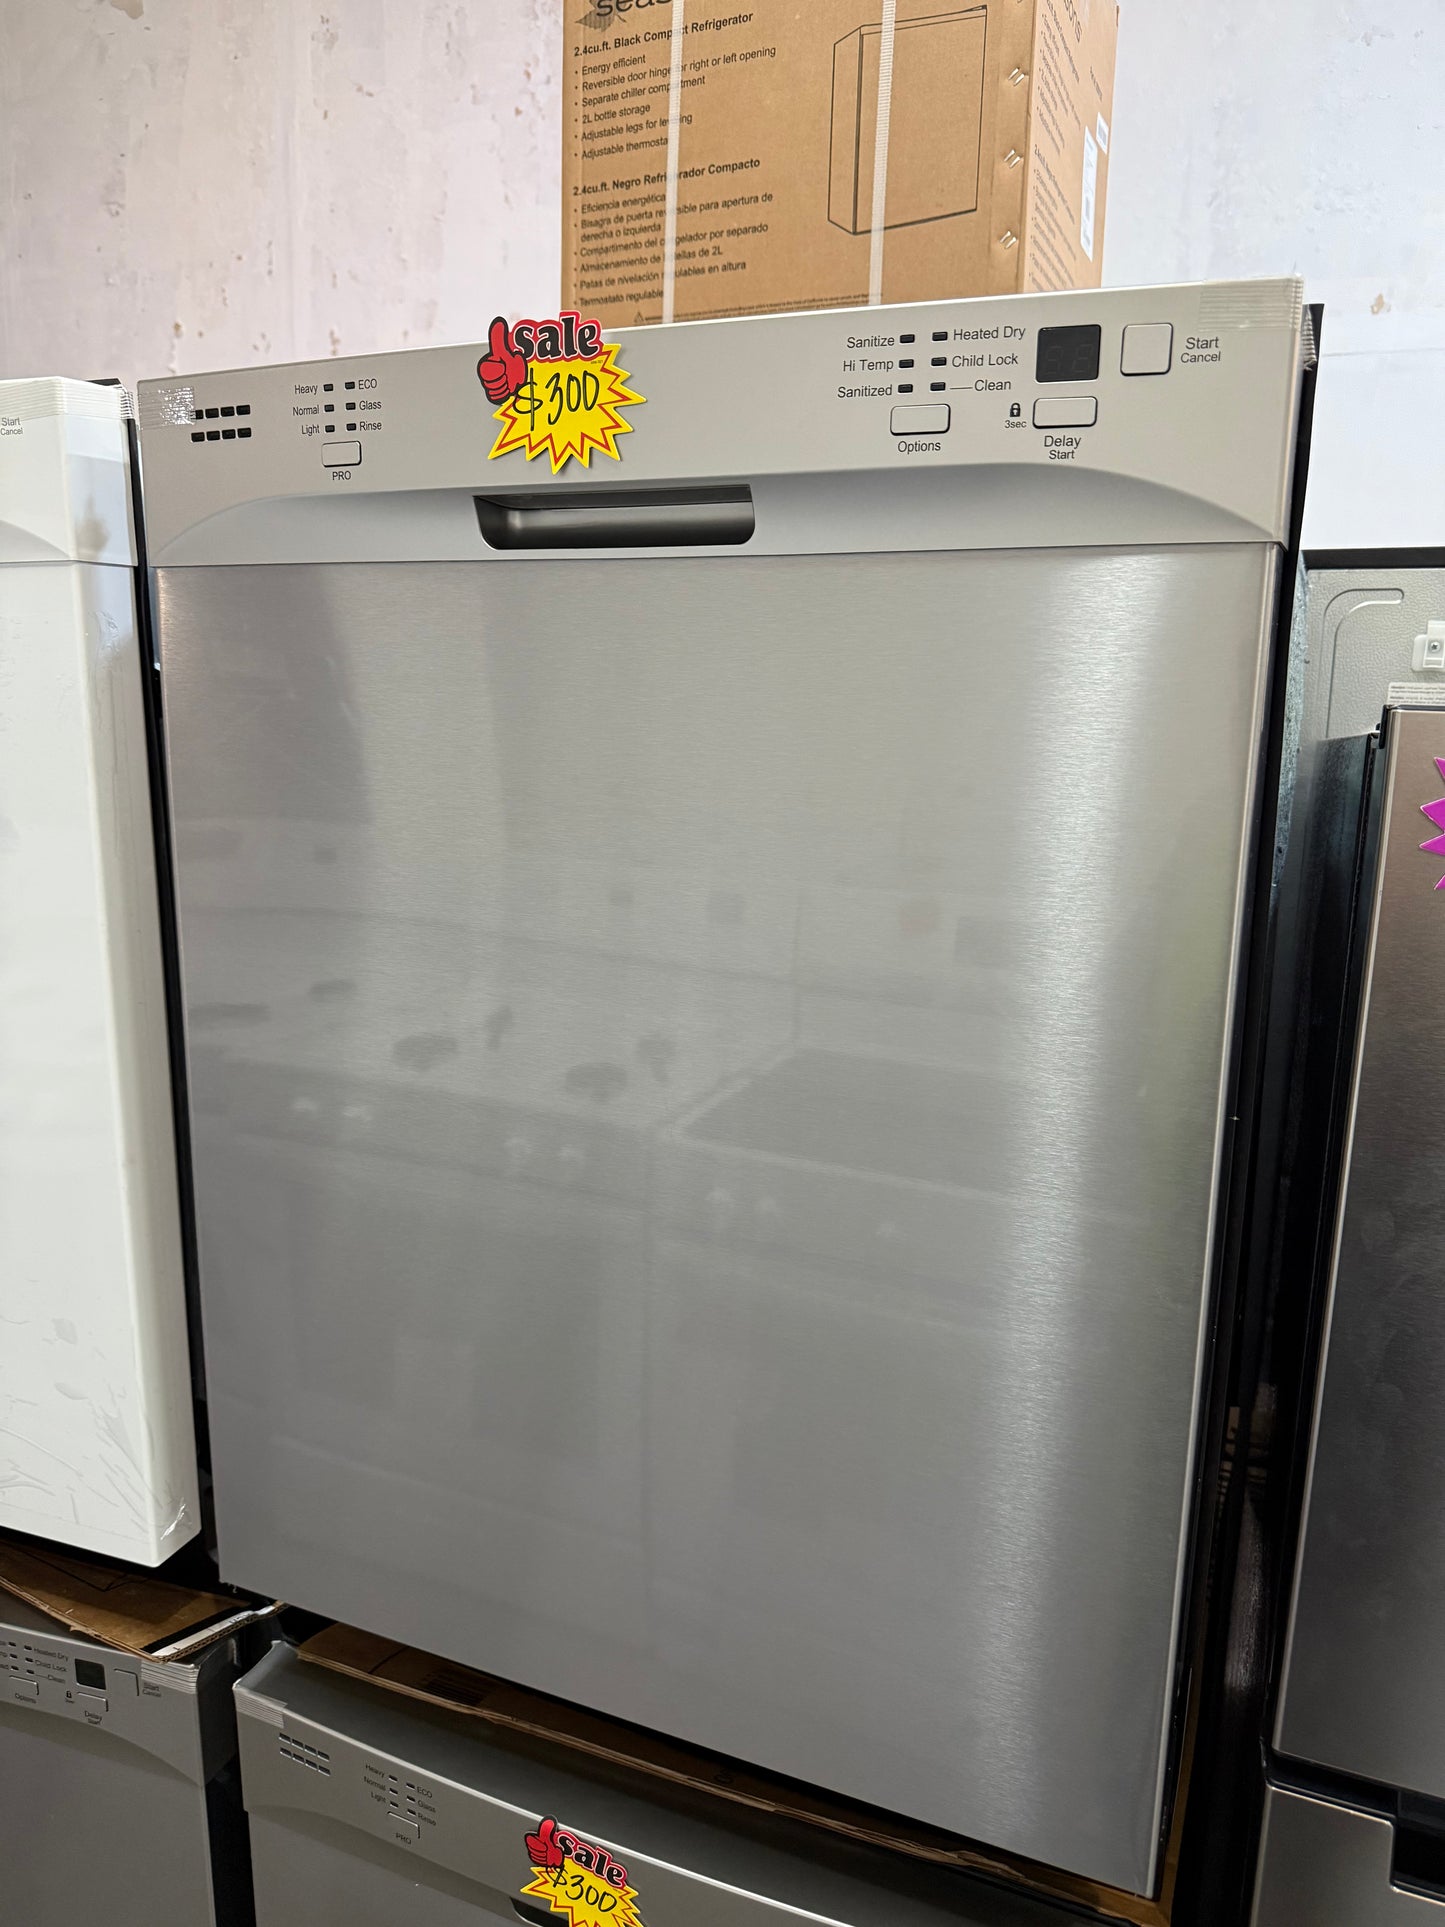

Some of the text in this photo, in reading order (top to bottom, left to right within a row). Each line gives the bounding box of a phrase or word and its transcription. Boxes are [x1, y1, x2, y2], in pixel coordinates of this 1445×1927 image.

[574, 41, 611, 57] 2.4cu.ft.
[614, 35, 641, 49] Black
[691, 13, 754, 33] Refrigerator
[582, 54, 646, 76] Energy efficient
[582, 76, 626, 92] Reversible
[627, 70, 647, 82] door
[690, 59, 709, 72] right
[711, 57, 721, 66] or
[723, 52, 737, 64] left
[739, 47, 776, 62] opening
[582, 75, 706, 108] Separate chiller comptment
[582, 104, 651, 124] 2L bottle storage
[581, 126, 624, 142] Adjustable
[626, 122, 643, 134] legs
[645, 119, 657, 130] for
[581, 143, 624, 160] Adjustable
[573, 158, 760, 196] 2.4cu.ft. Negro Refrirador Compacto
[581, 201, 620, 214] Eficiencia
[581, 192, 773, 230] Bisagra de puerta revsible para apertura de
[580, 230, 613, 242] derecha
[623, 223, 661, 238] izquierda
[580, 241, 643, 258] Compartimento
[644, 238, 657, 248] del
[709, 229, 724, 242] por
[726, 222, 768, 238] separado
[580, 257, 648, 272] Almacenamiento
[650, 255, 661, 264] de
[698, 247, 709, 257] de
[711, 246, 723, 255] 2L
[580, 279, 603, 289] Patas
[605, 277, 615, 286] de
[707, 264, 719, 273] en
[721, 261, 746, 272] altura
[514, 315, 600, 359] sale
[953, 325, 1026, 341] Heated Dry
[847, 335, 895, 349] Sanitize
[1185, 336, 1220, 351] Start
[952, 353, 1019, 368] Child Lock
[1180, 351, 1221, 364] Cancel
[843, 358, 894, 373] Hi Temp
[294, 384, 318, 396] Heavy
[358, 378, 378, 390] ECO
[837, 384, 893, 398] Sanitized
[974, 379, 1012, 392] Clean
[358, 400, 382, 411] Glass
[512, 367, 600, 431] $300
[292, 404, 320, 417] Normal
[1, 417, 21, 427] Start
[359, 421, 383, 431] Rinse
[1004, 419, 1027, 429] 3sec
[0, 427, 24, 436] Cancel
[301, 424, 320, 436] Light
[897, 440, 941, 455] Options
[1043, 434, 1082, 450] Delay
[1048, 449, 1075, 461] Start
[332, 471, 352, 482] PRO
[365, 1763, 385, 1779] Heavy
[363, 1776, 386, 1792] Normal
[371, 1791, 386, 1804] Light
[417, 1786, 433, 1799] ECO
[395, 1832, 412, 1845] PRO
[558, 1835, 624, 1886] sale
[545, 1864, 618, 1913] $300
